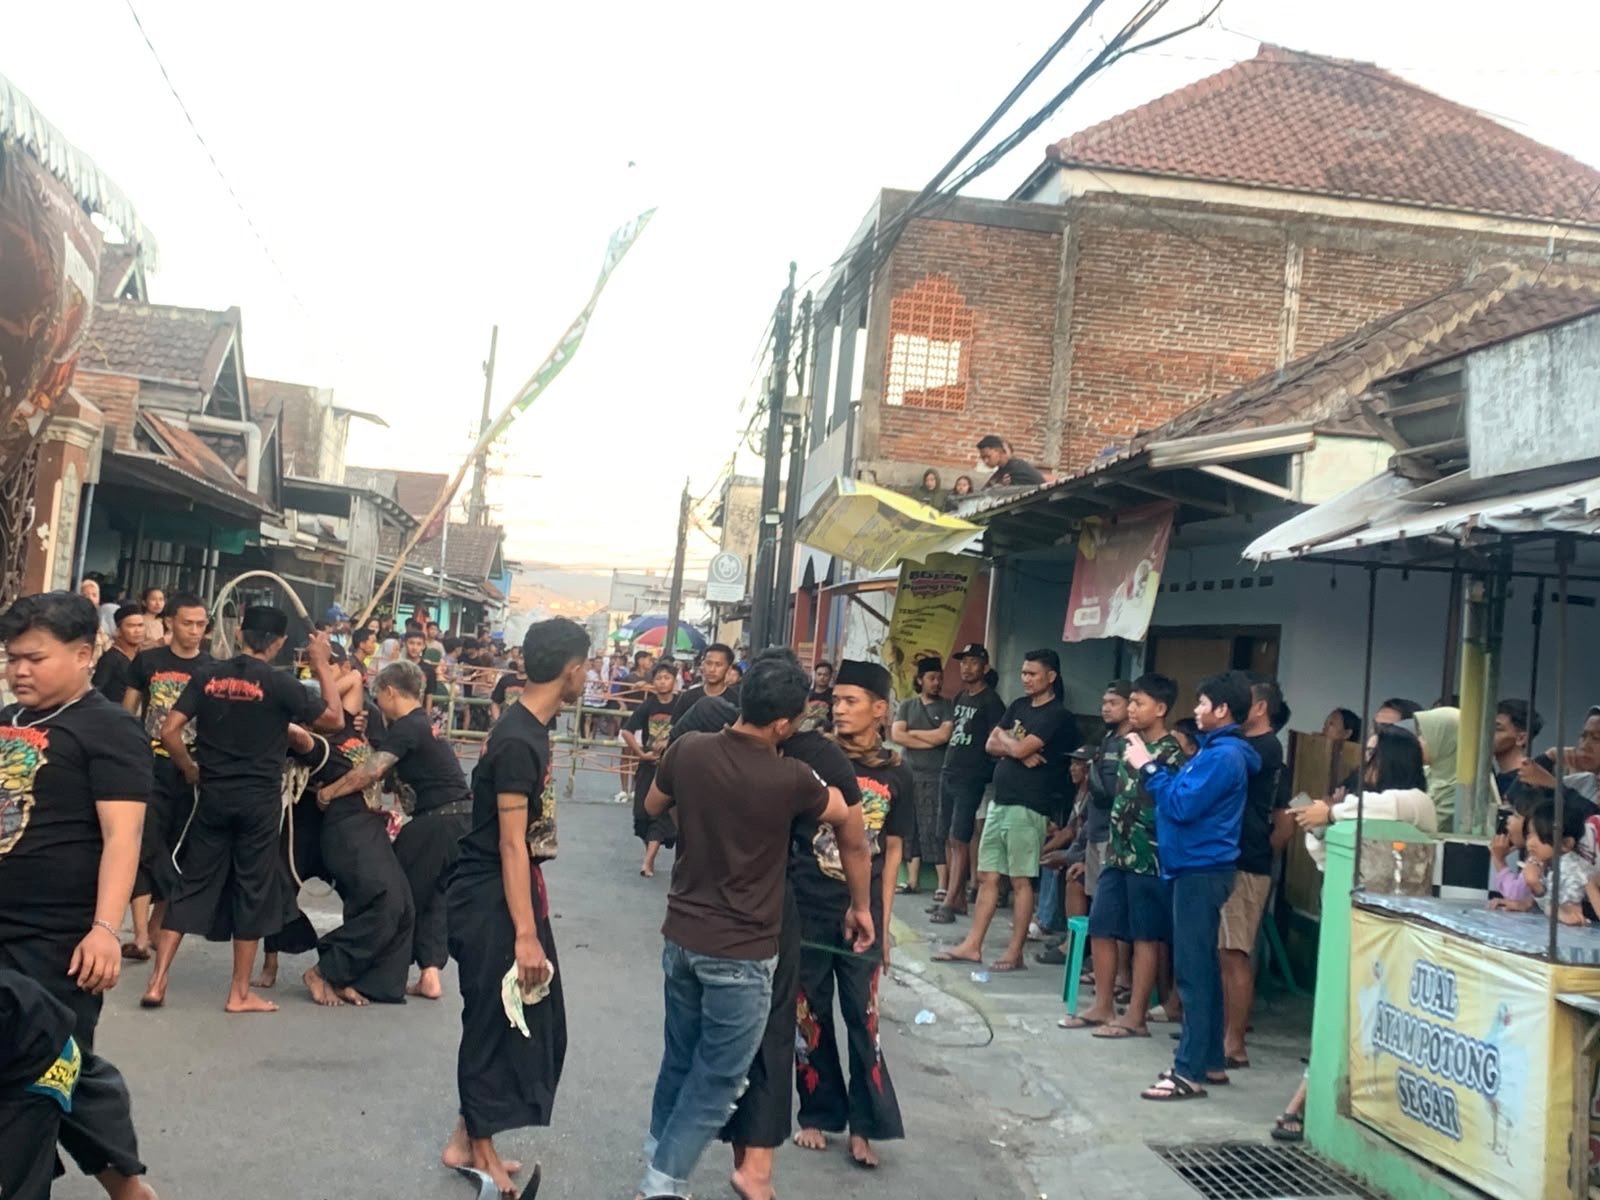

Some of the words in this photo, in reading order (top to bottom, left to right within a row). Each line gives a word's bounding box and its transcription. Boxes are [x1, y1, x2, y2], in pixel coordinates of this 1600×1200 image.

[954, 704, 977, 719] STAY
[1411, 961, 1457, 1019] JUAL
[1373, 1003, 1415, 1061] AYAM
[1416, 1022, 1499, 1096] POTONG
[1397, 1068, 1460, 1140] SEGAR
